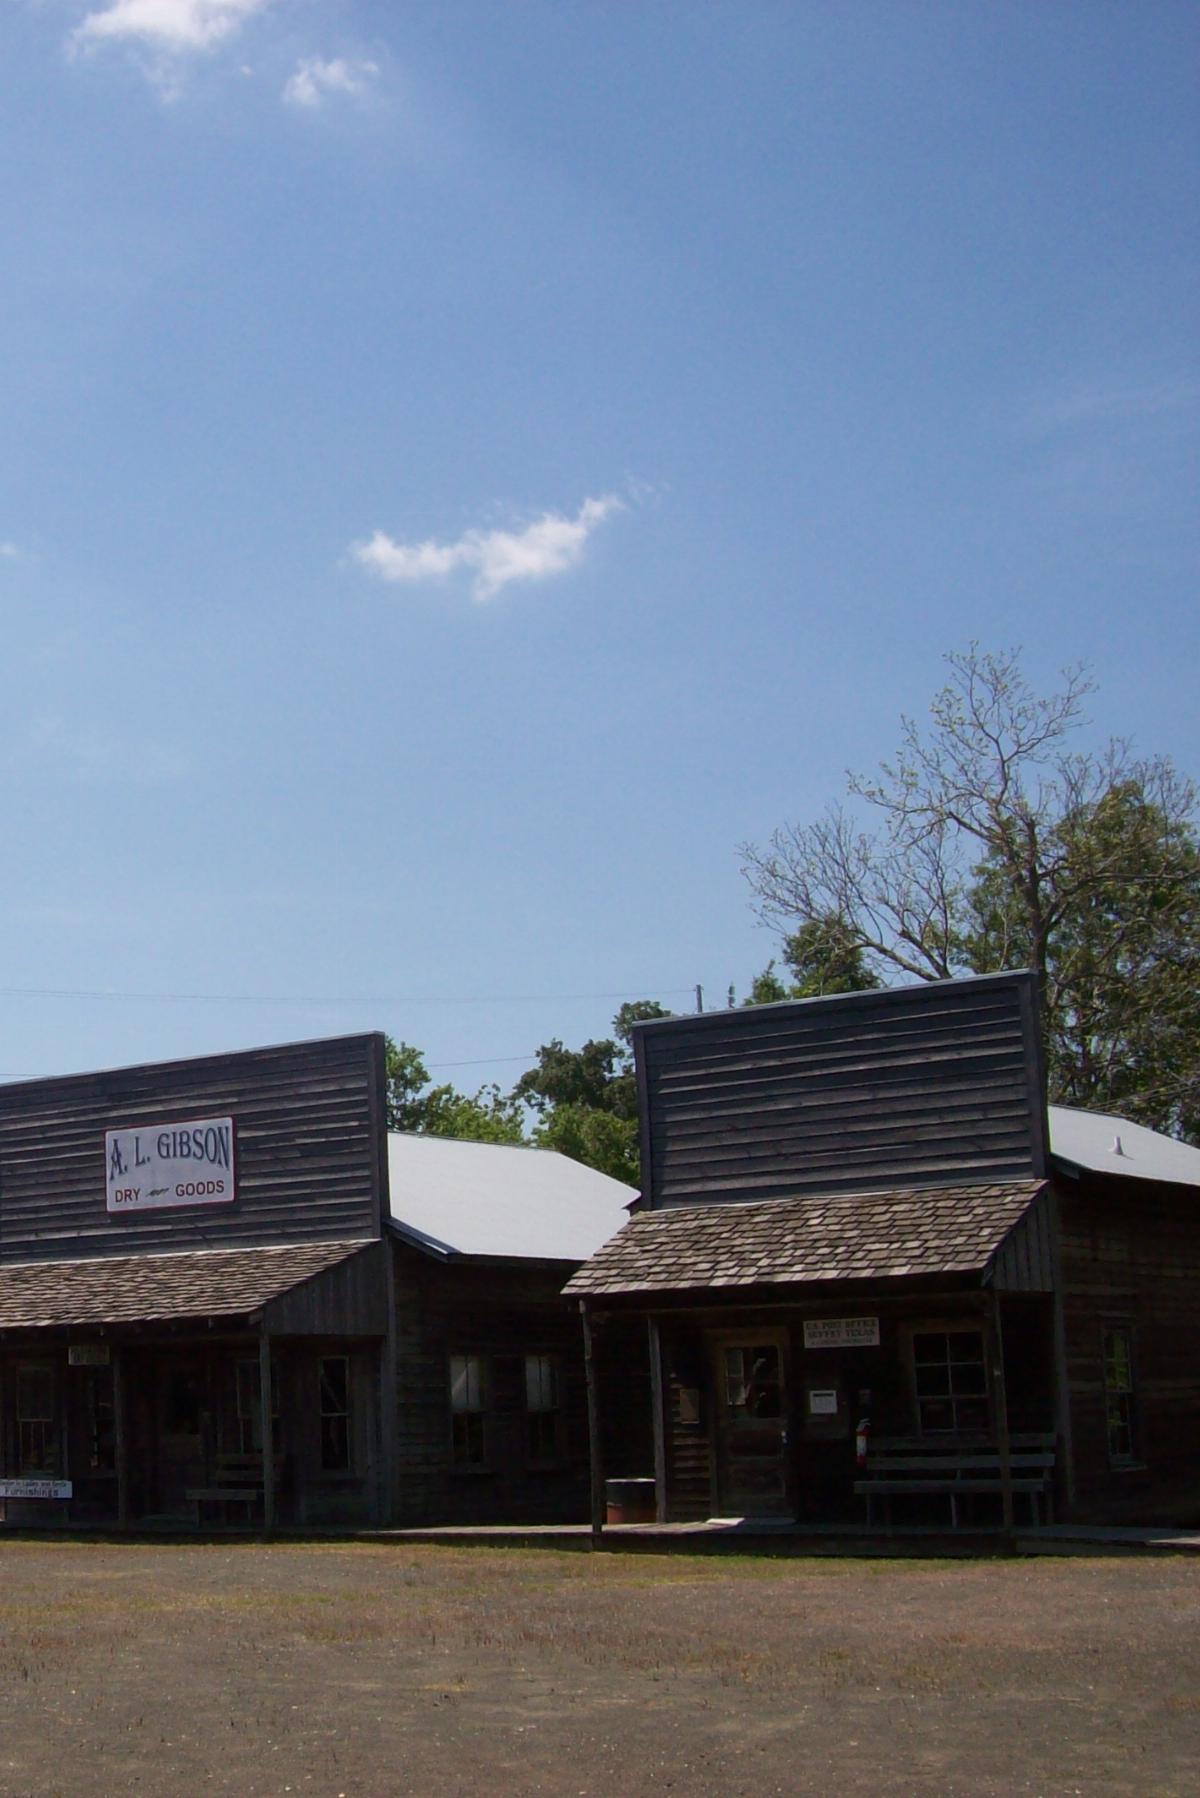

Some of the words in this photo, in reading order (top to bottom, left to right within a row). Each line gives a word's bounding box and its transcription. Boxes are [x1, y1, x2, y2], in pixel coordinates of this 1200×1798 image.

[109, 1138, 128, 1181] A.
[134, 1135, 151, 1167] L.
[156, 1126, 230, 1171] GIBSON
[114, 1188, 141, 1203] DRY
[174, 1180, 225, 1197] GOODS
